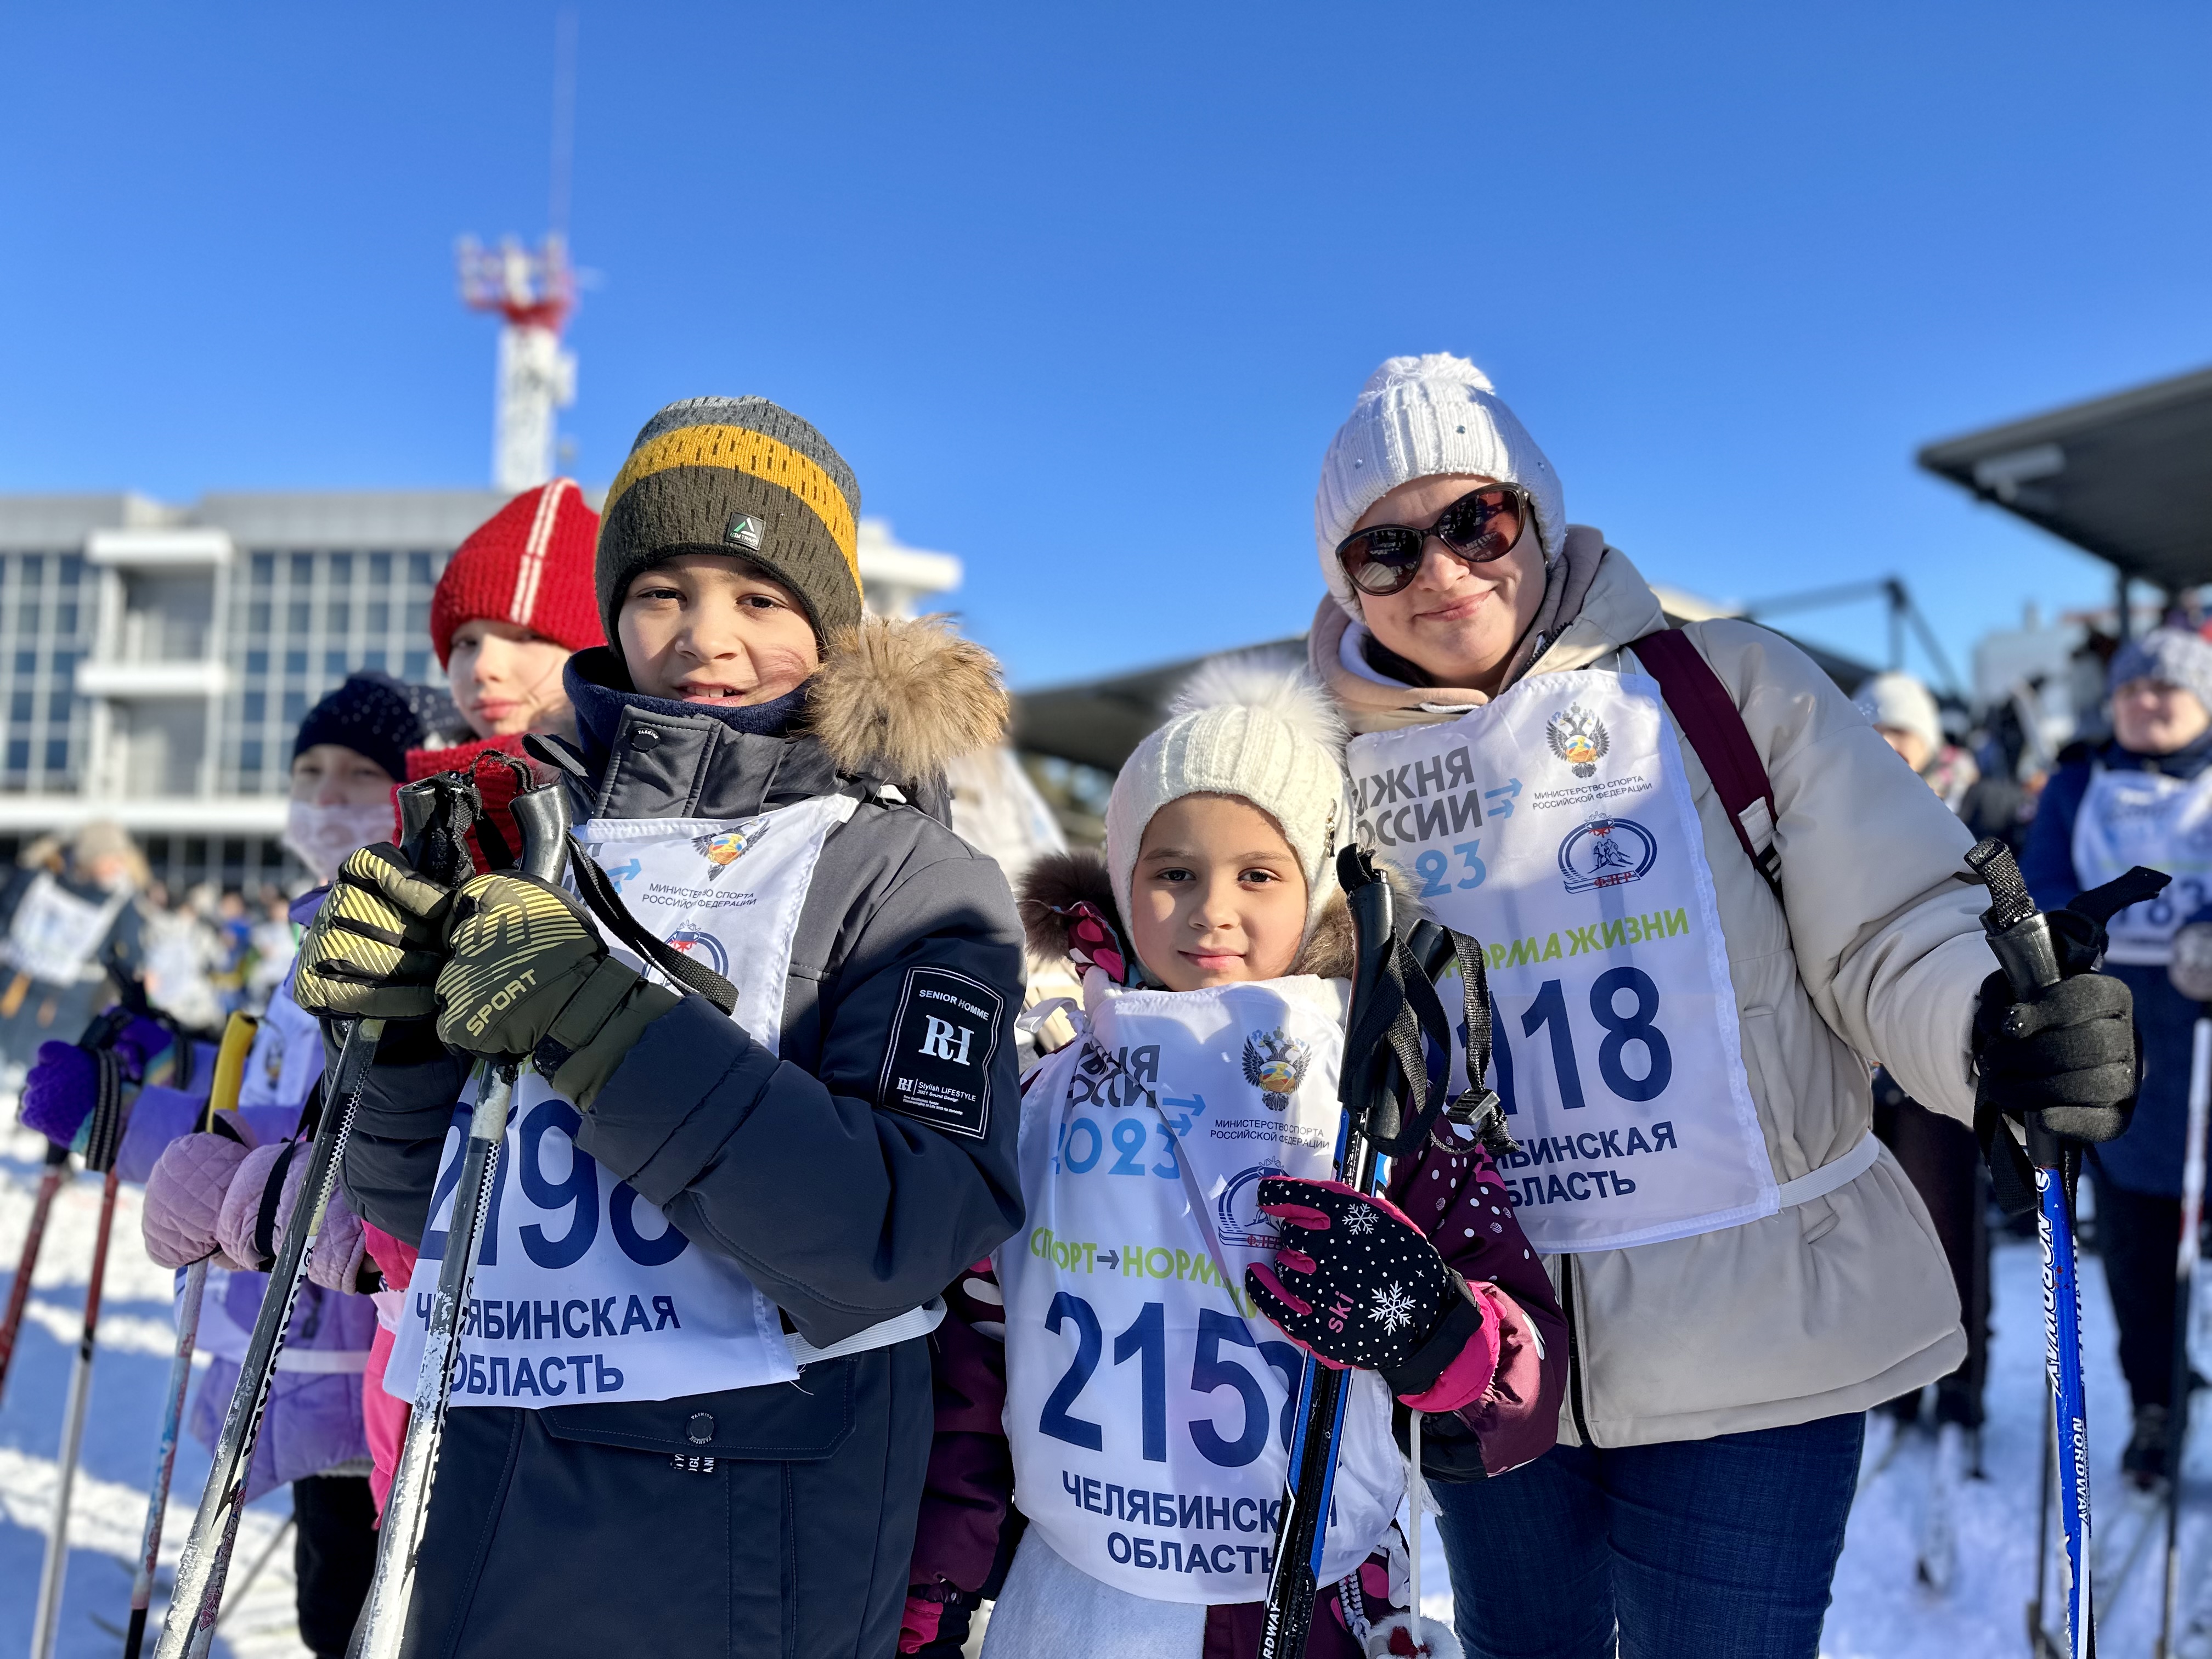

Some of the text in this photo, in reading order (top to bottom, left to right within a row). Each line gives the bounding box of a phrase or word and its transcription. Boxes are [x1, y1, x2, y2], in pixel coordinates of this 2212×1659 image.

[1532, 782, 1653, 810] РОССИЙСКОЙ ФЕДЕРАЦИИ
[1534, 775, 1644, 799] МИНИСТЕРСТВО СПОРТА
[649, 883, 754, 899] МИНИСТЕРО СПОРТА
[1391, 839, 1486, 899] 23
[642, 894, 757, 909] РОССИЙС ФЕДЕРАЦИИ
[1565, 907, 1690, 956] ЖИЗНИ
[466, 968, 537, 1037] SPORT
[919, 989, 990, 1020] SENIOR HOMME
[1424, 967, 1672, 1115] 118
[918, 1082, 940, 1092] Stylish
[941, 1086, 977, 1102] LIFESTYLE
[1052, 1117, 1181, 1179] 023
[1210, 1129, 1330, 1149] РОССИЙСКОЙ ФЕДЕРАЦИИ
[1215, 1119, 1324, 1137] МИНИСТЕРСТВО СПОРТА
[1506, 1170, 1637, 1207] БЛАСТЬ
[1030, 1227, 1229, 1287] СПОРТ НОРМ
[415, 1293, 681, 1340] ЧЯБИНСКАЯ
[1328, 1290, 1355, 1333] ski
[2038, 1211, 2063, 1398] NORDWAY
[2072, 1416, 2089, 1526] NORDWAY
[1062, 1471, 1338, 1533] ЧЕЛЯБИНСК
